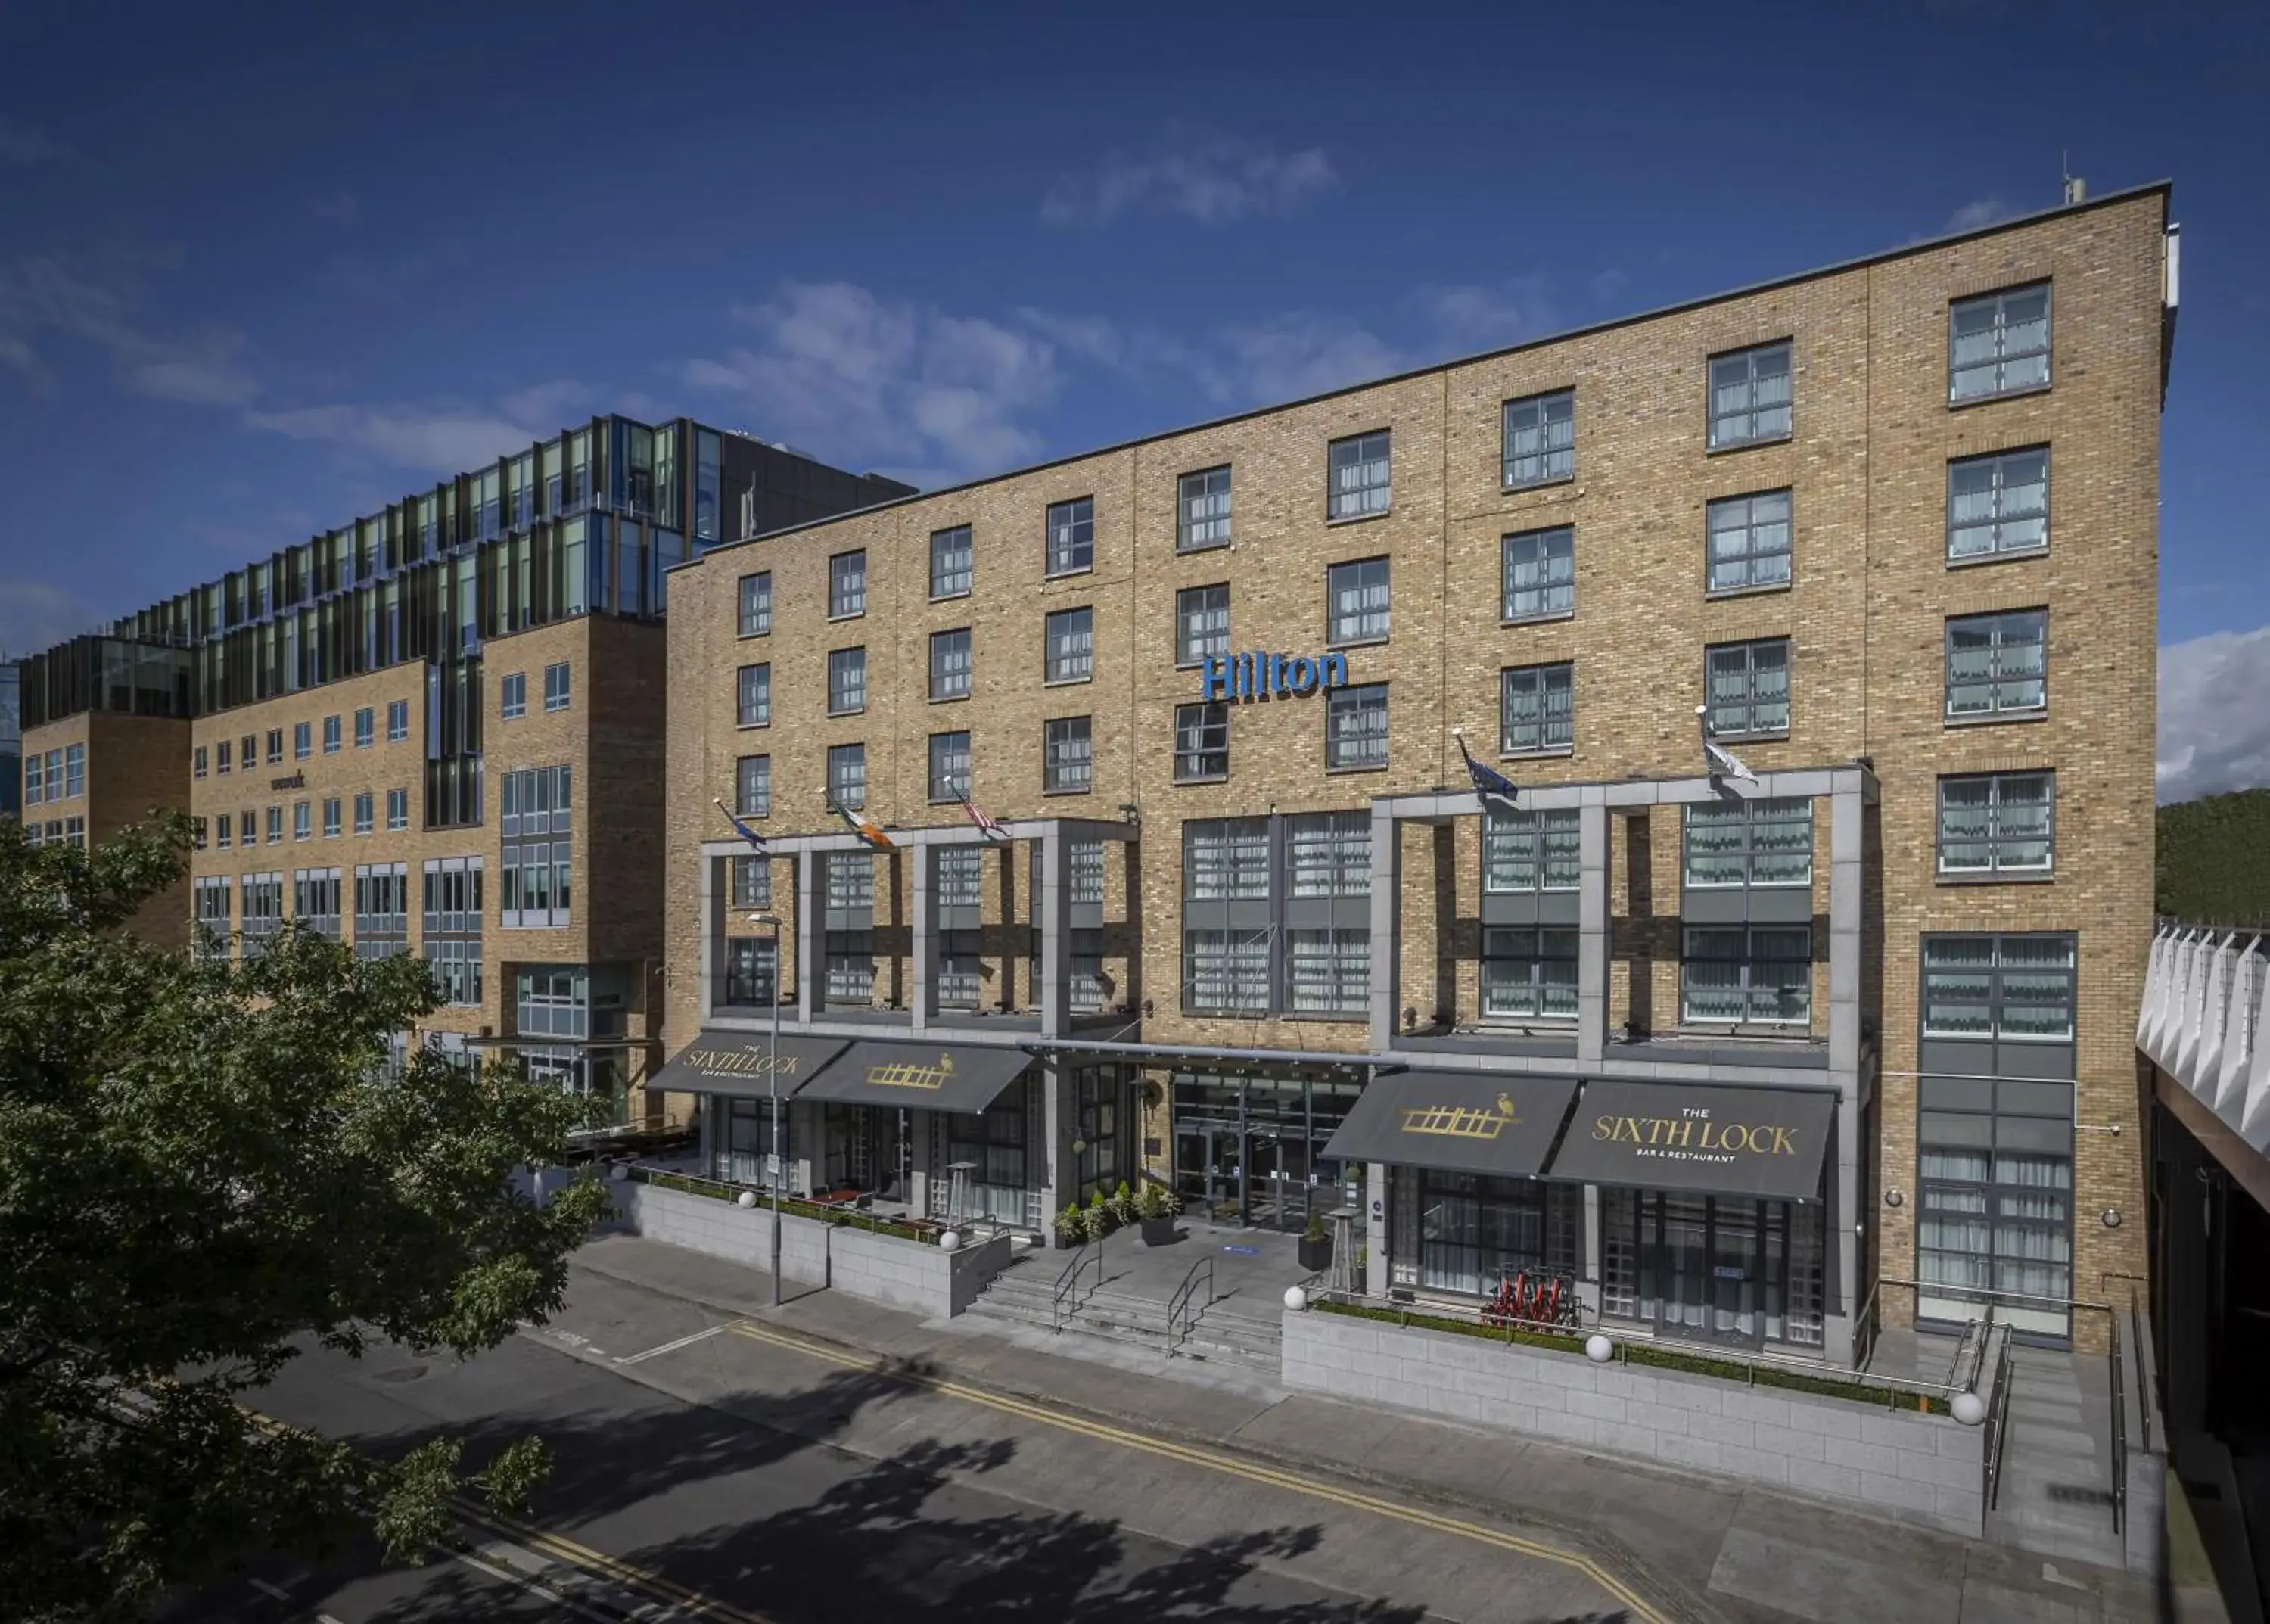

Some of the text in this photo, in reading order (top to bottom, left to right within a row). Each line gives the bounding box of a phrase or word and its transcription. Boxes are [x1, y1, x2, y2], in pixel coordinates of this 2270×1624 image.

[1203, 649, 1346, 700] Hilton
[1682, 1107, 1710, 1118] THE
[1591, 1115, 1799, 1155] SIXTH LOCK
[1636, 1148, 1656, 1157] BAR
[1668, 1150, 1736, 1163] RESTAURANT
